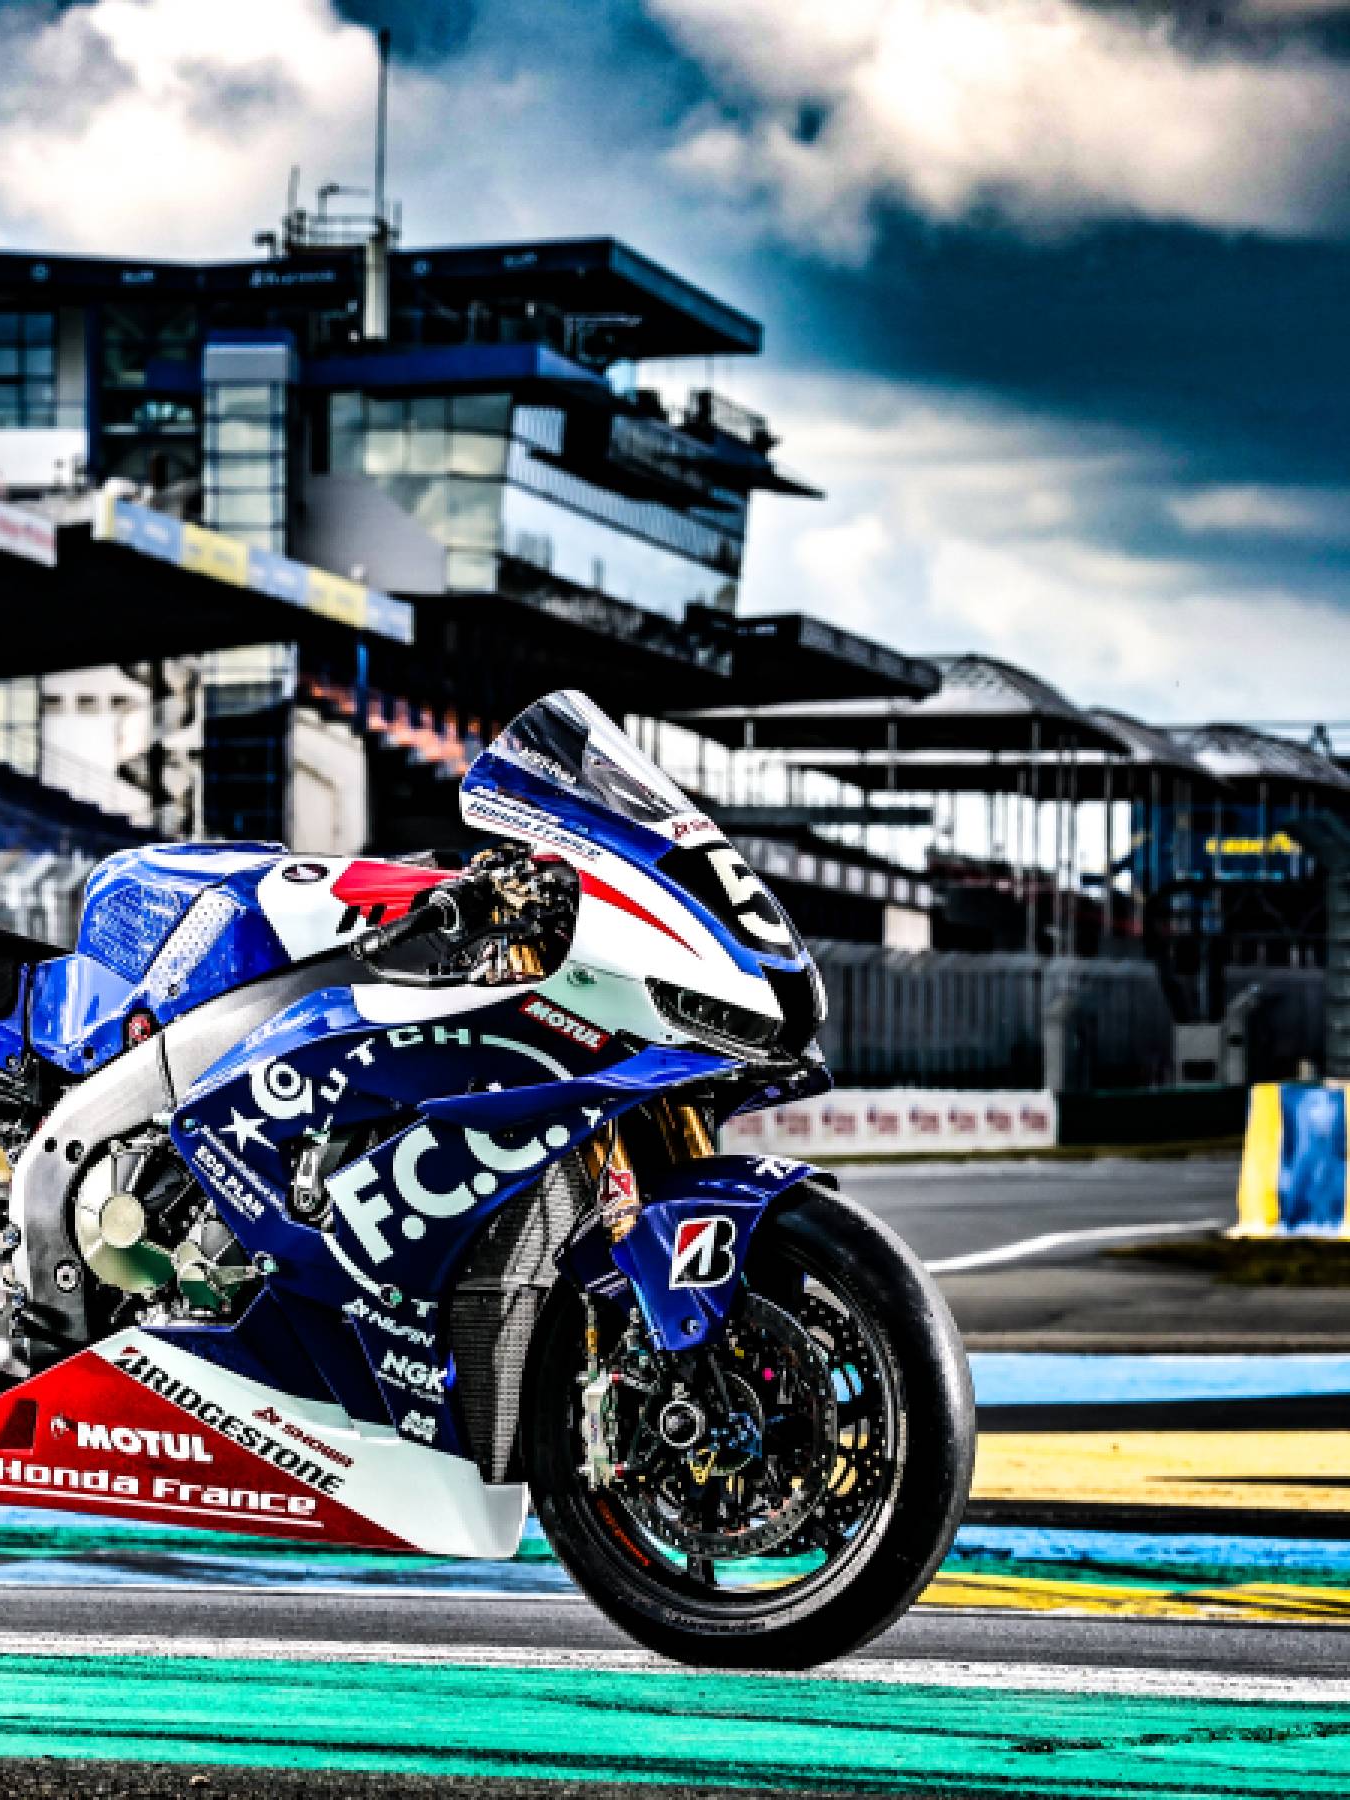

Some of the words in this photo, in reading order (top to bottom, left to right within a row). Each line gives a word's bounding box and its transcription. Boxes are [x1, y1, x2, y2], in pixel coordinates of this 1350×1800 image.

[525, 1001, 601, 1048] MOTUL
[380, 1349, 448, 1392] NGK
[112, 1345, 346, 1495] BRIDGESTONE
[76, 1421, 214, 1463] MOTUL
[152, 1477, 317, 1516] France
